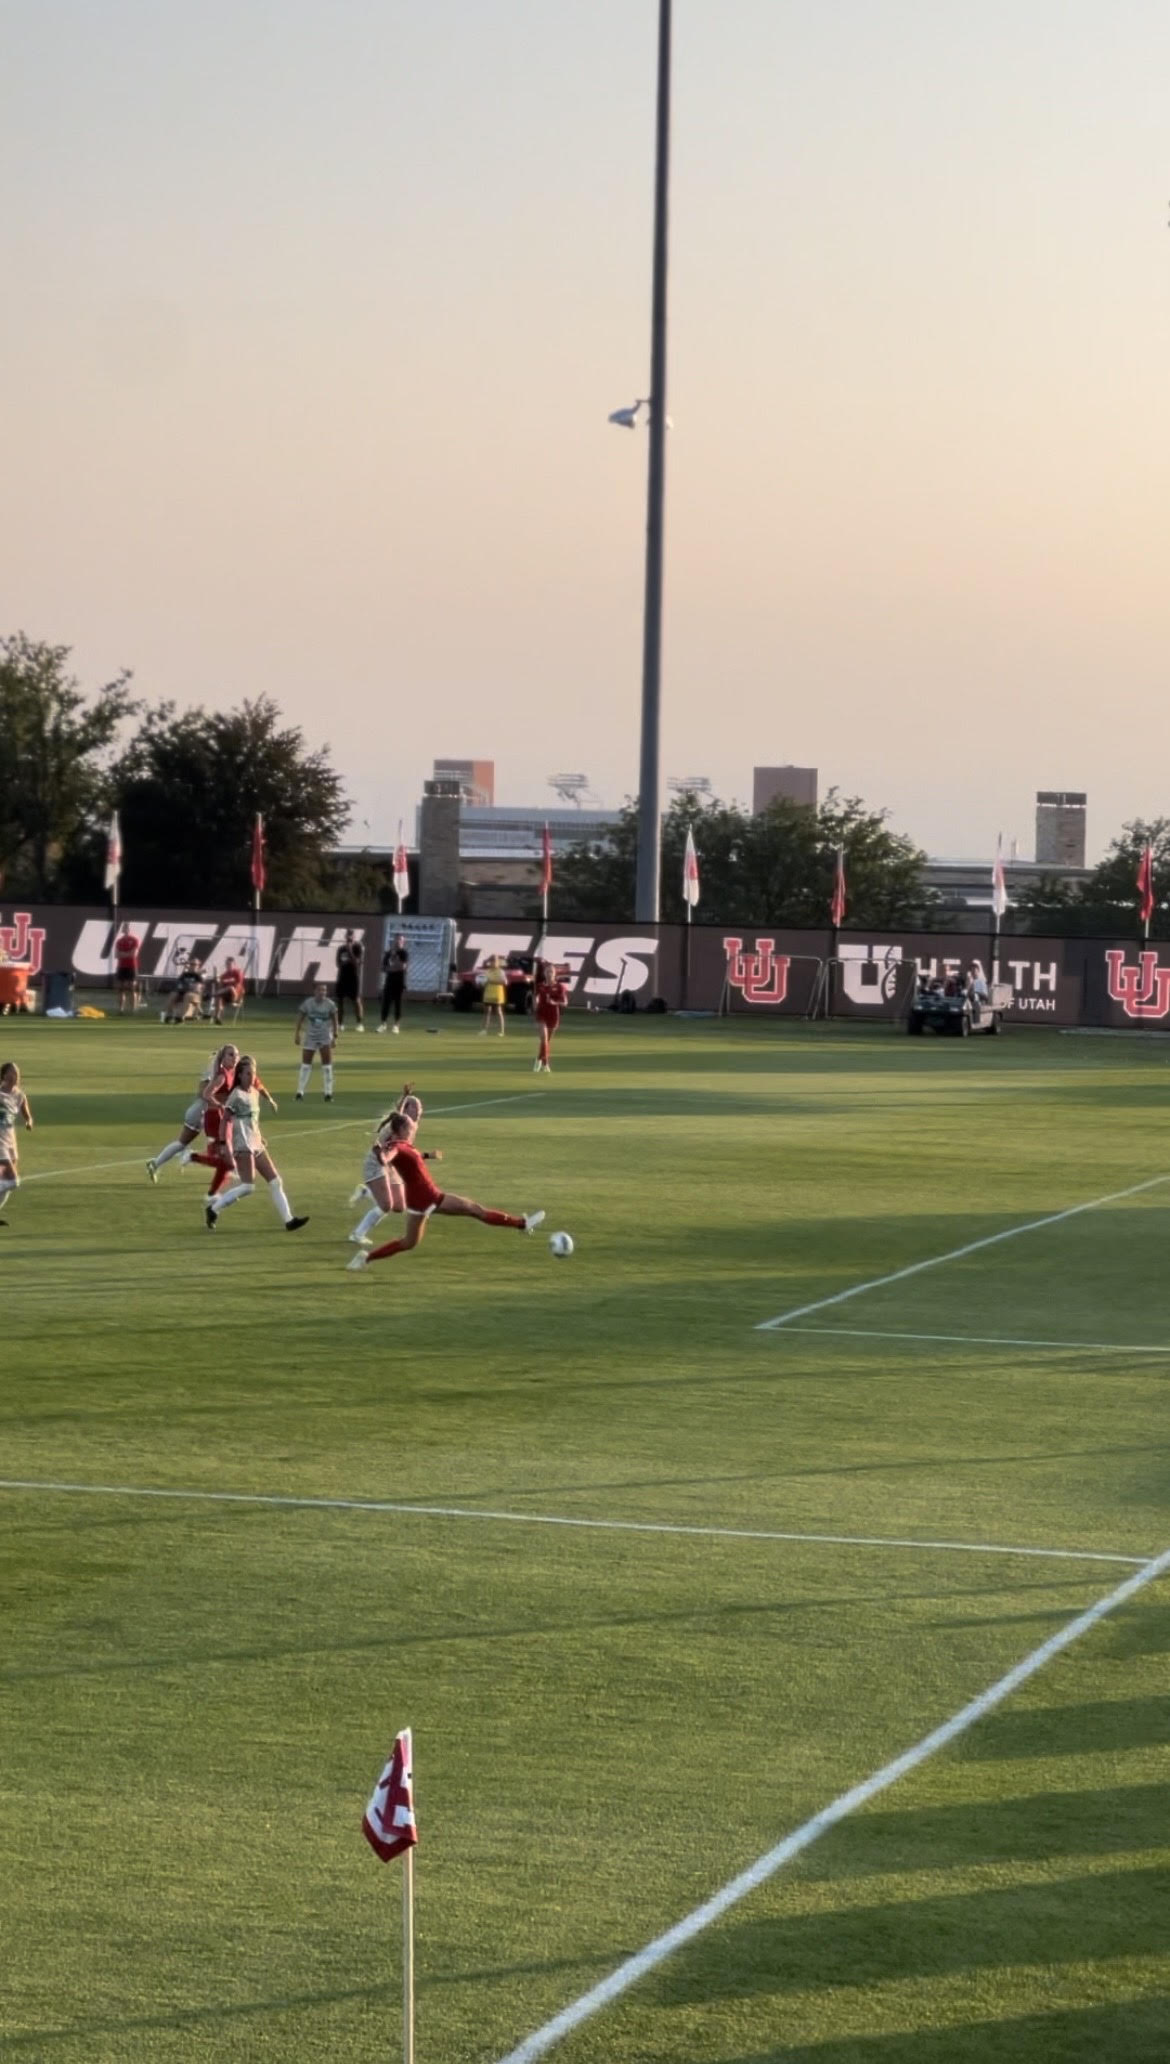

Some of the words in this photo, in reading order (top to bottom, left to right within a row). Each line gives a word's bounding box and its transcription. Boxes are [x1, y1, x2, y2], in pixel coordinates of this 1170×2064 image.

[71, 919, 366, 982] UTAH
[454, 931, 659, 994] TES
[1018, 997, 1056, 1011] UTAH
